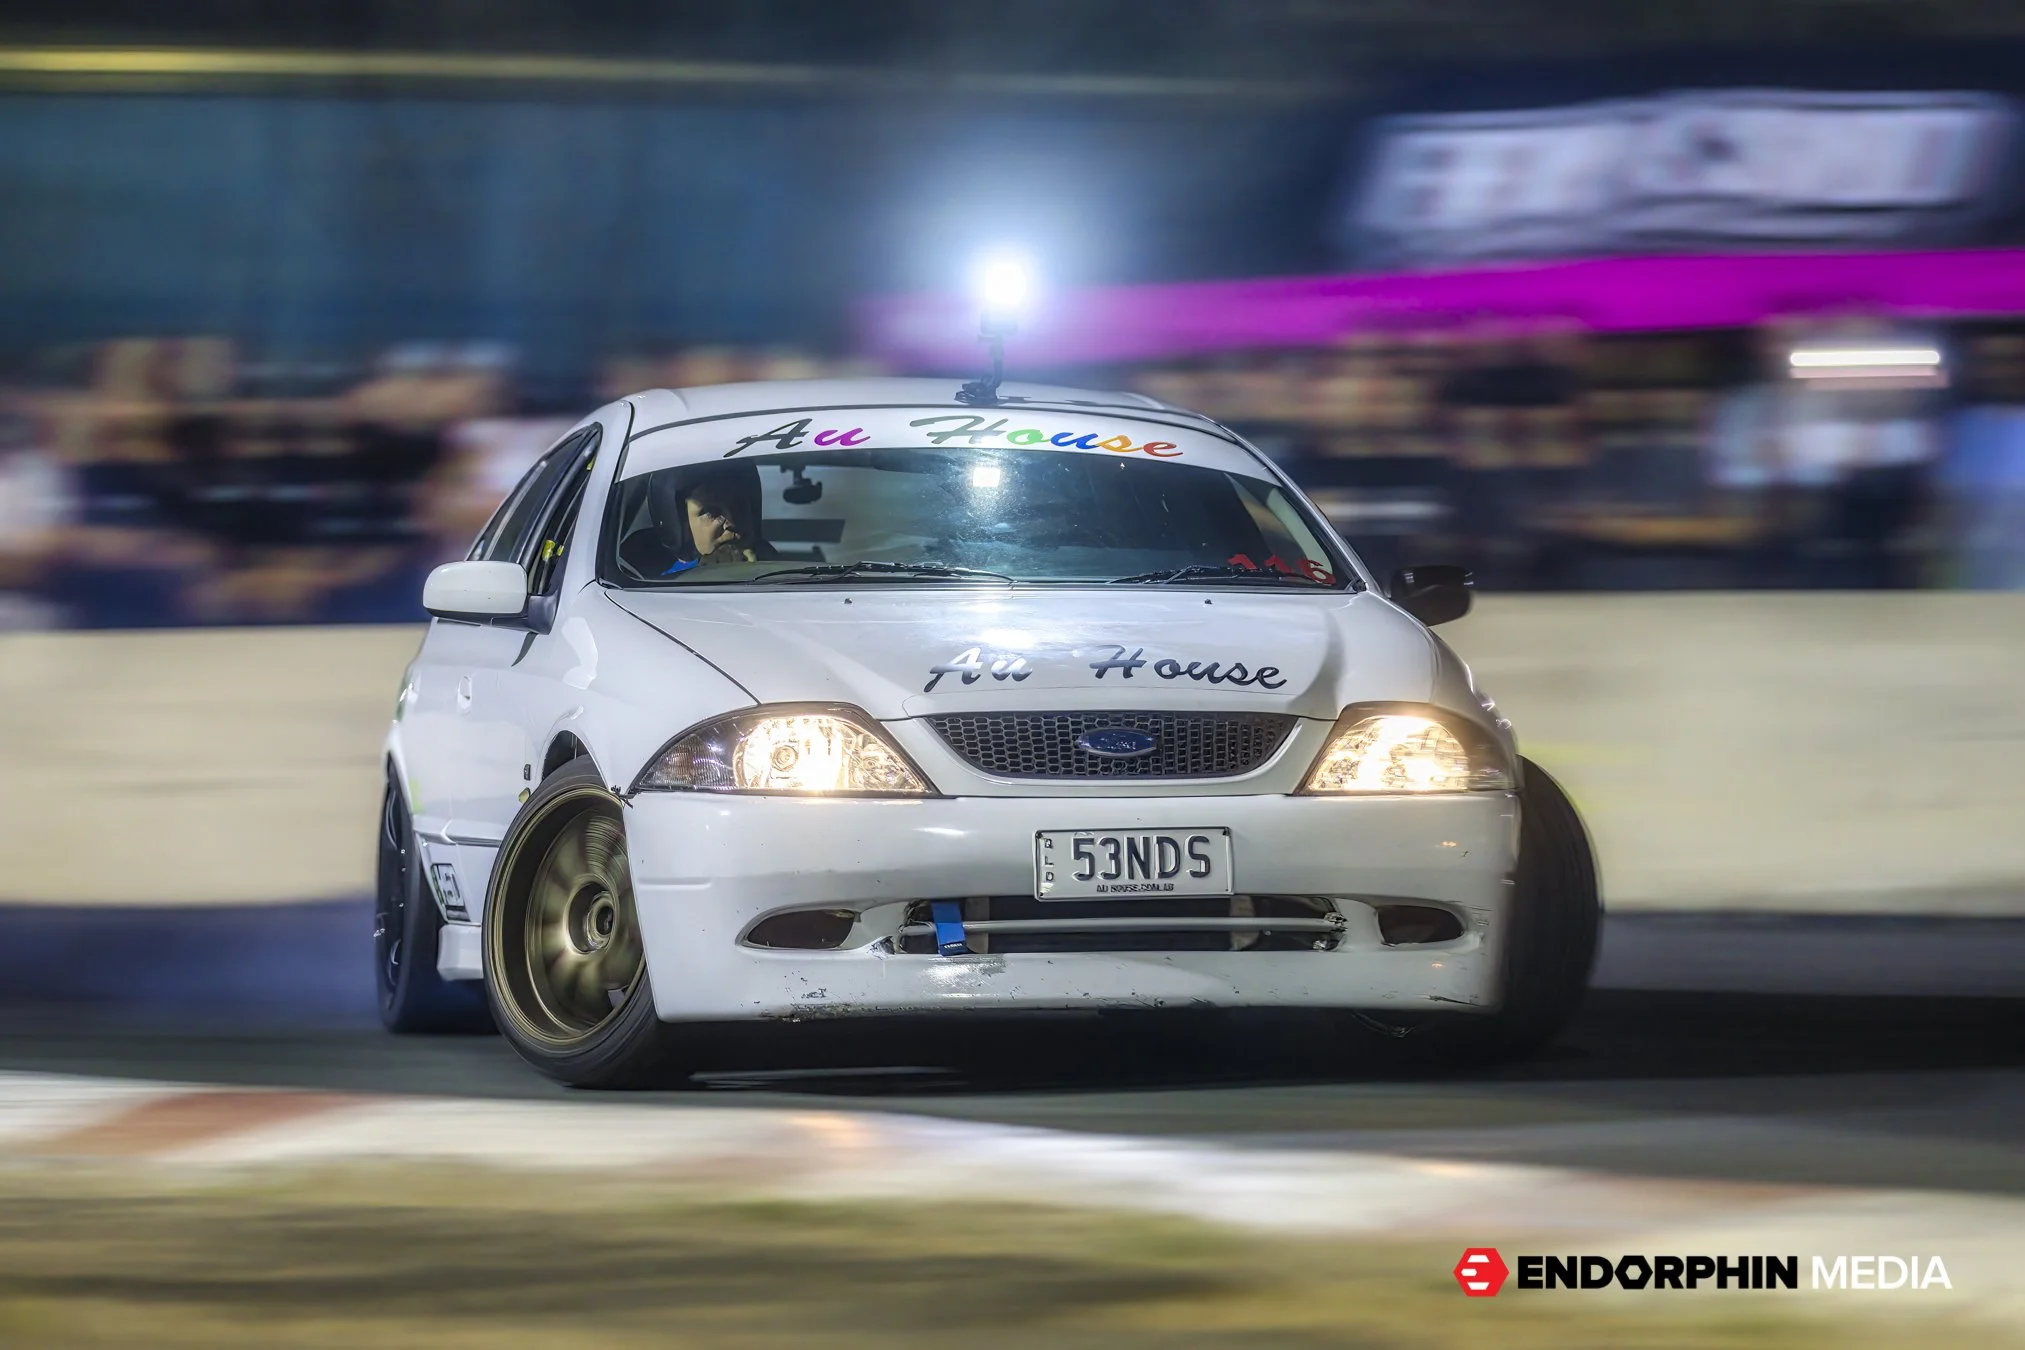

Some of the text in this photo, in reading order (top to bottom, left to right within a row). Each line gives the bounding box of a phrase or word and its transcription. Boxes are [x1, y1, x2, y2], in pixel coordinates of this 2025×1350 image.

[724, 415, 1184, 458] Au House
[923, 644, 1288, 693] Au House
[1072, 835, 1211, 881] 53NDS
